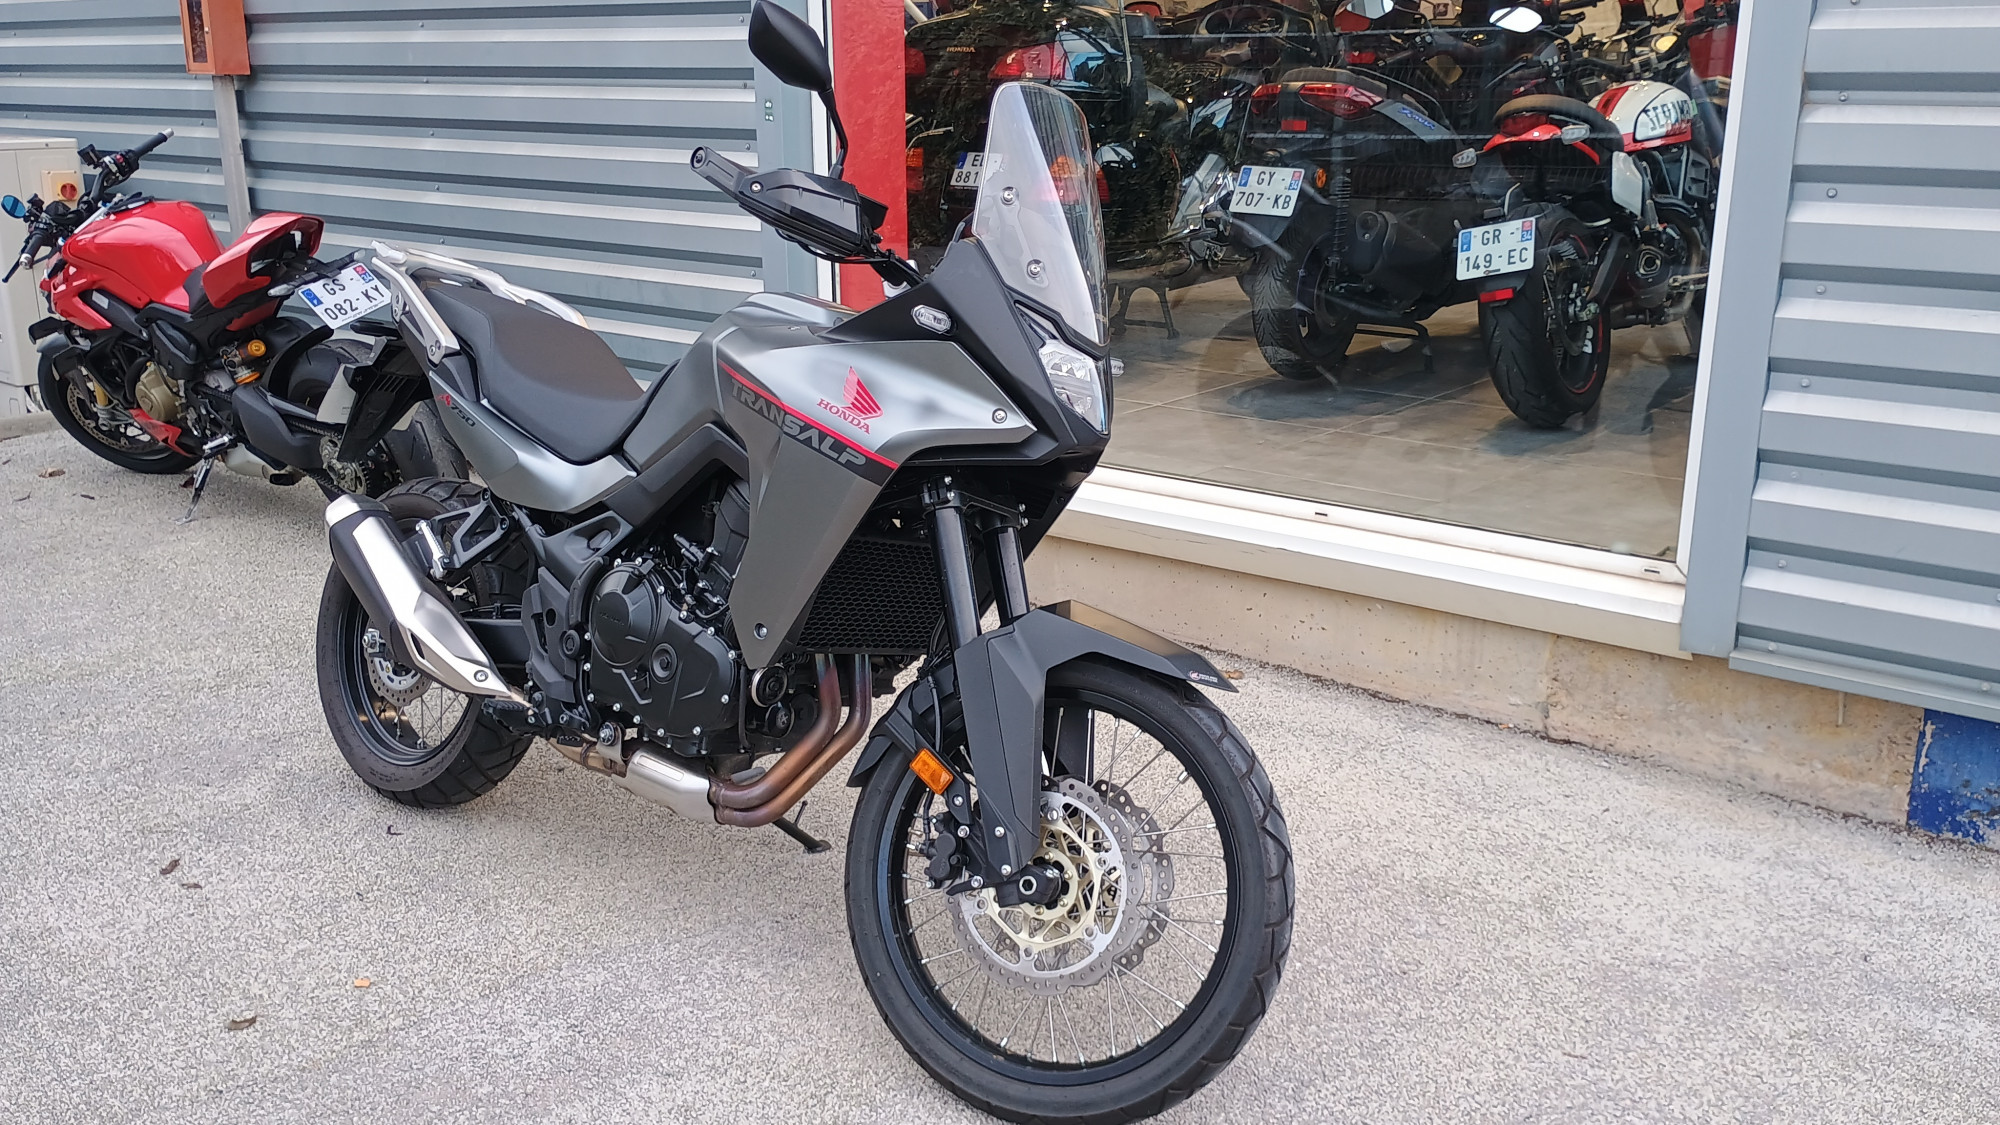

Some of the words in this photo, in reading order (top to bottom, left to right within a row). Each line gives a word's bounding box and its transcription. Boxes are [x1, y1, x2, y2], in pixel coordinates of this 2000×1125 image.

[955, 171, 979, 184] 881
[731, 378, 867, 466] TRANSALP
[816, 398, 871, 435] HONDA
